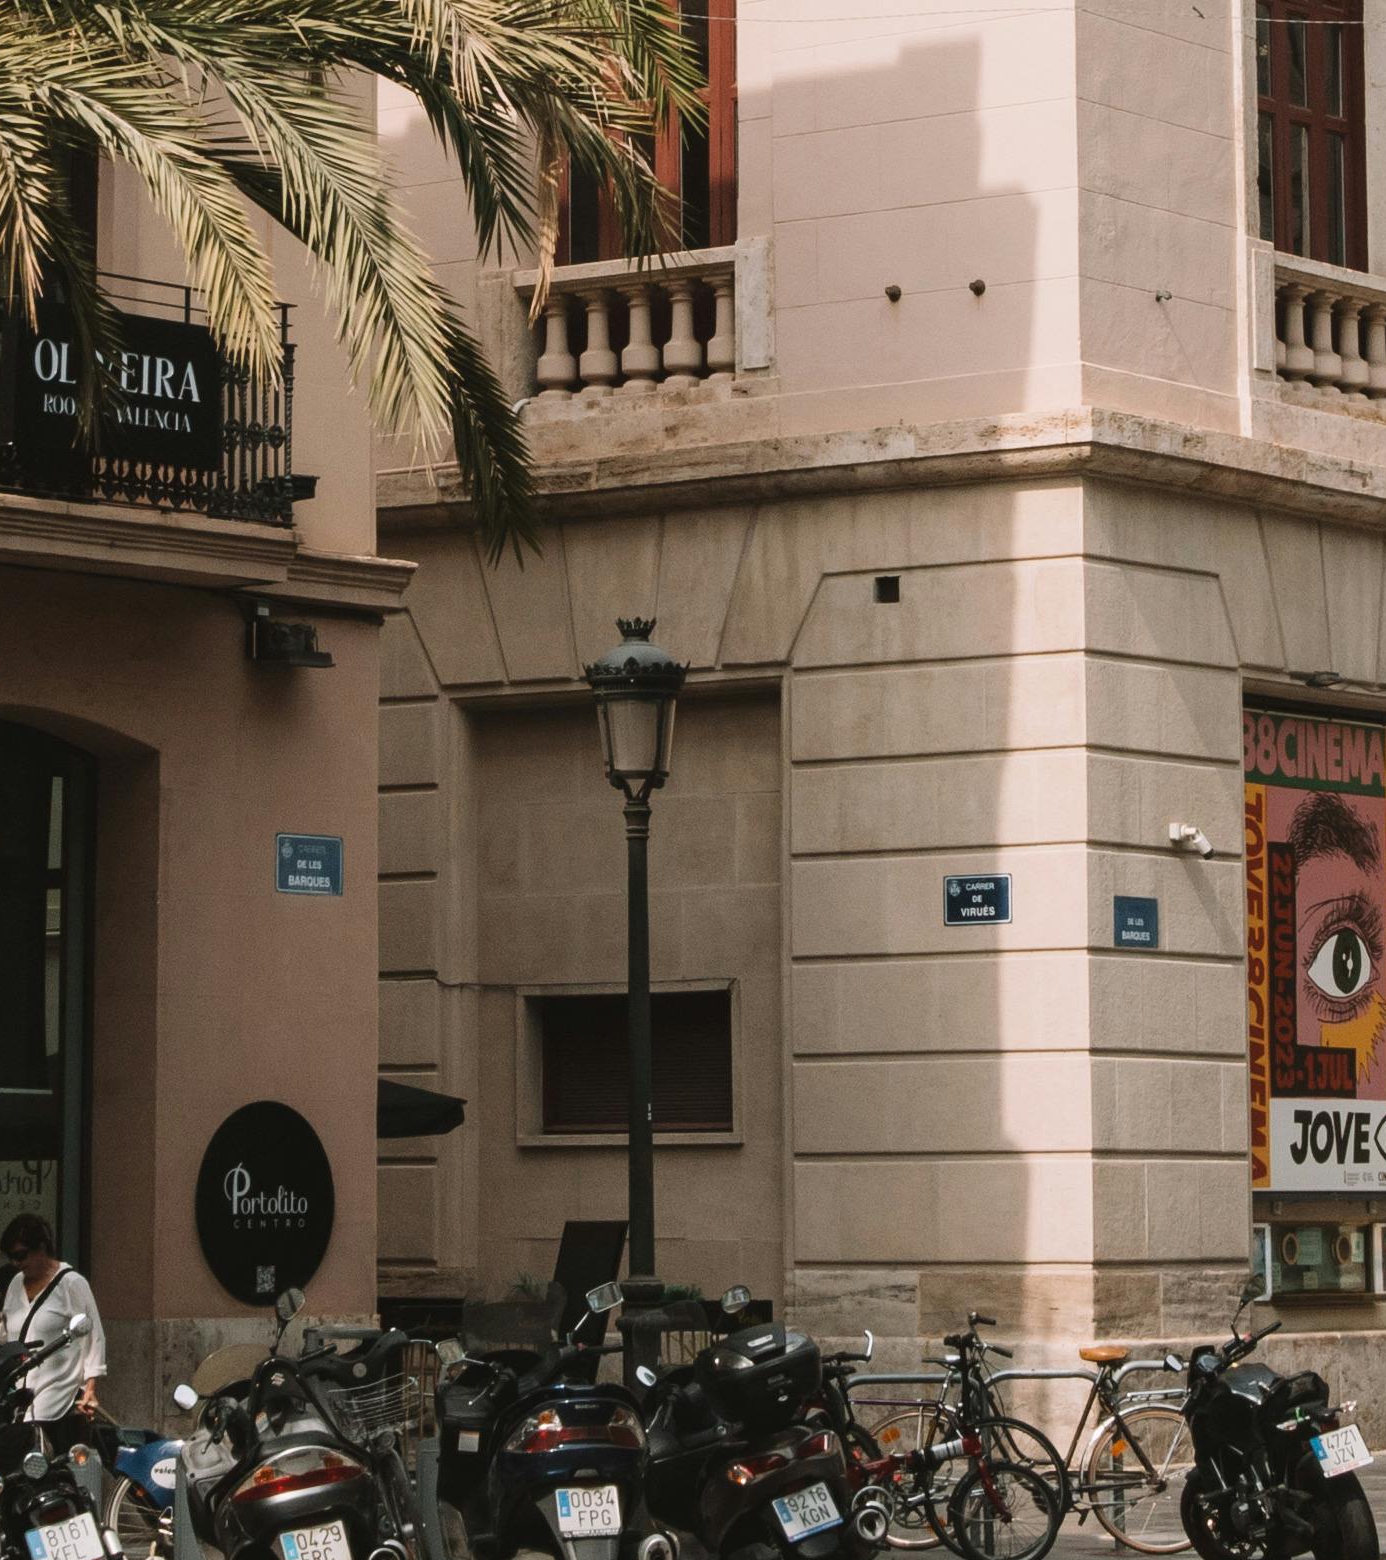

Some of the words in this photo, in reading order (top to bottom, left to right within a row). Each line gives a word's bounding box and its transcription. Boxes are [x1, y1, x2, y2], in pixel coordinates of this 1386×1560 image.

[34, 338, 201, 403] OLEIRA
[117, 404, 191, 433] VALENCIA
[1244, 711, 1386, 787] 38CINEMA
[297, 859, 307, 869] DE
[308, 860, 322, 870] LES
[288, 874, 331, 888] BARQUES
[965, 882, 995, 891] CARRER
[972, 895, 983, 903] DE
[960, 904, 995, 917] VIRUÉS
[1121, 929, 1150, 941] BARQUES
[1290, 1109, 1371, 1165] JOVE
[223, 1161, 308, 1215] Portolito
[233, 1218, 305, 1229] CENTRO
[1326, 1429, 1358, 1450] 4721
[1333, 1445, 1355, 1465] JZV
[570, 1486, 615, 1508] 0034
[790, 1486, 828, 1513] 9216
[578, 1509, 612, 1526] FPG
[800, 1504, 831, 1528] KGN
[45, 1519, 90, 1548] 8161
[296, 1525, 342, 1551] 0429
